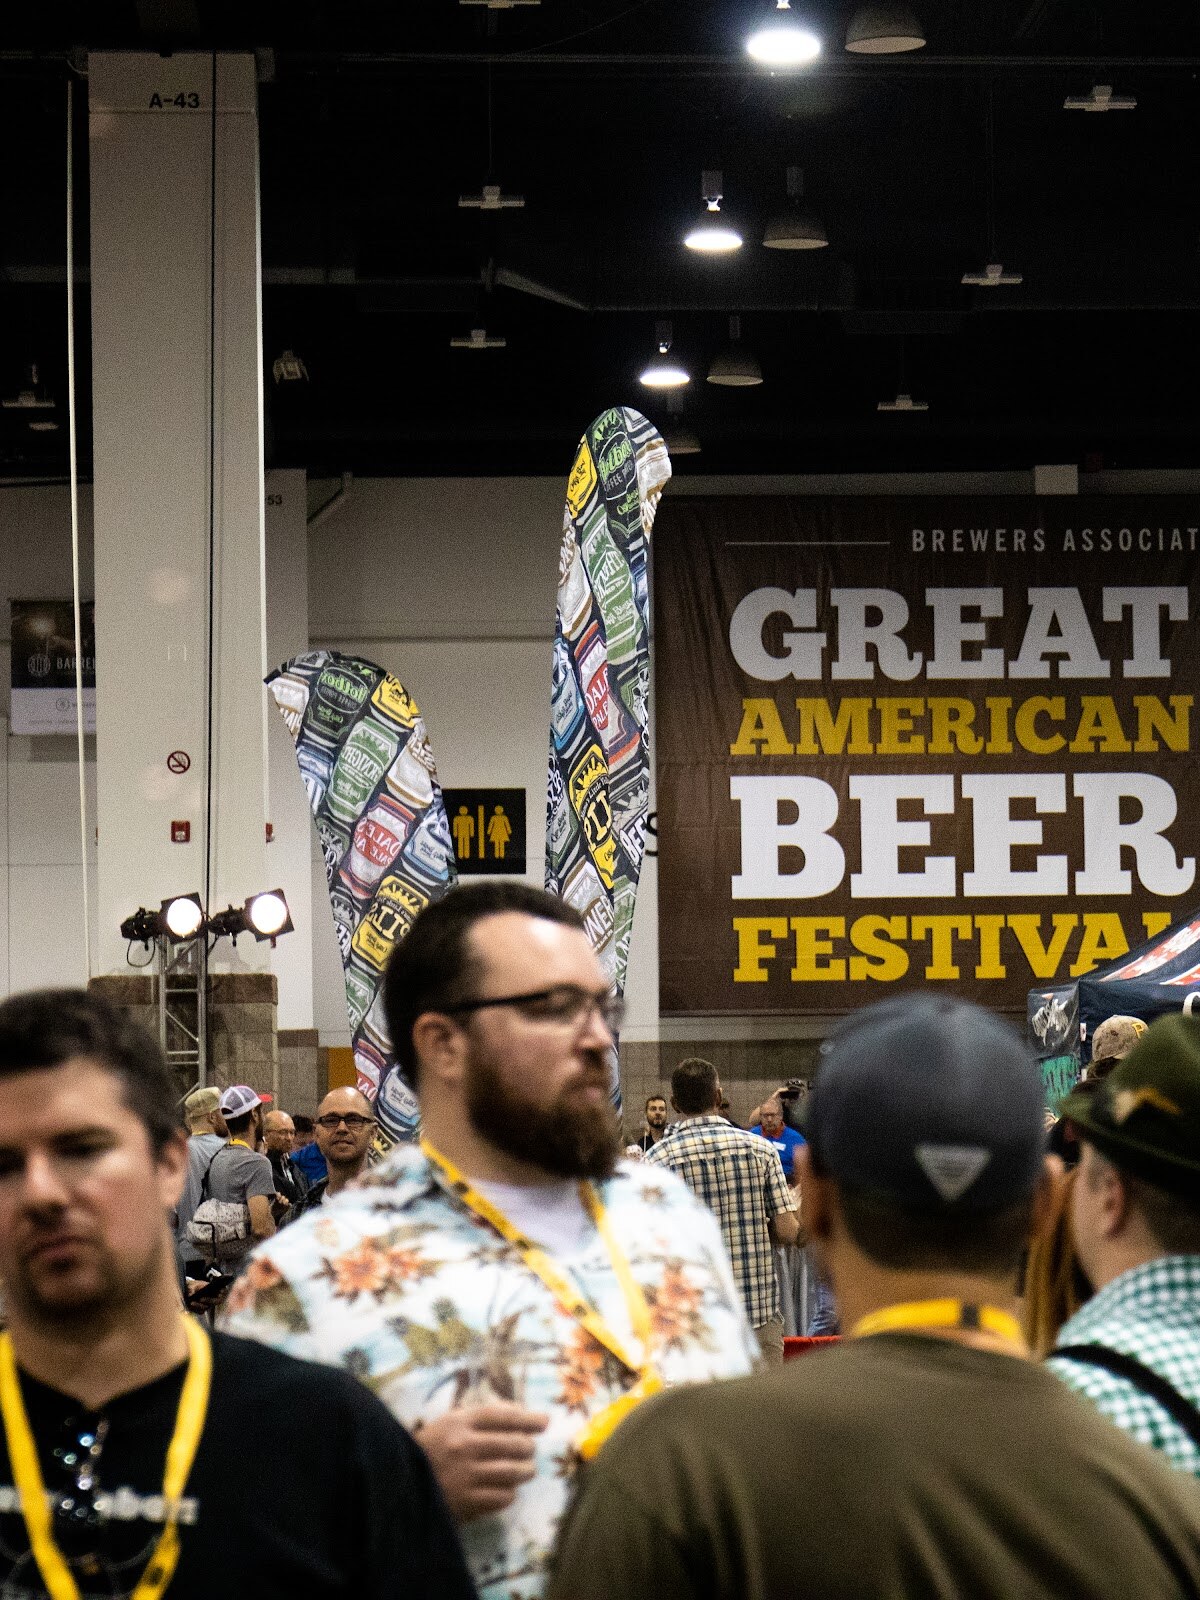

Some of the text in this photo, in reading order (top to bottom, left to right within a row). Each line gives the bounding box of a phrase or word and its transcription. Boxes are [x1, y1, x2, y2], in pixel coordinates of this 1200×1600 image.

[148, 92, 200, 109] A-43
[912, 528, 1046, 551] BREWERS
[729, 586, 1189, 682] GREAT
[730, 694, 1194, 755] AMERICAN
[730, 772, 1196, 900] BEER
